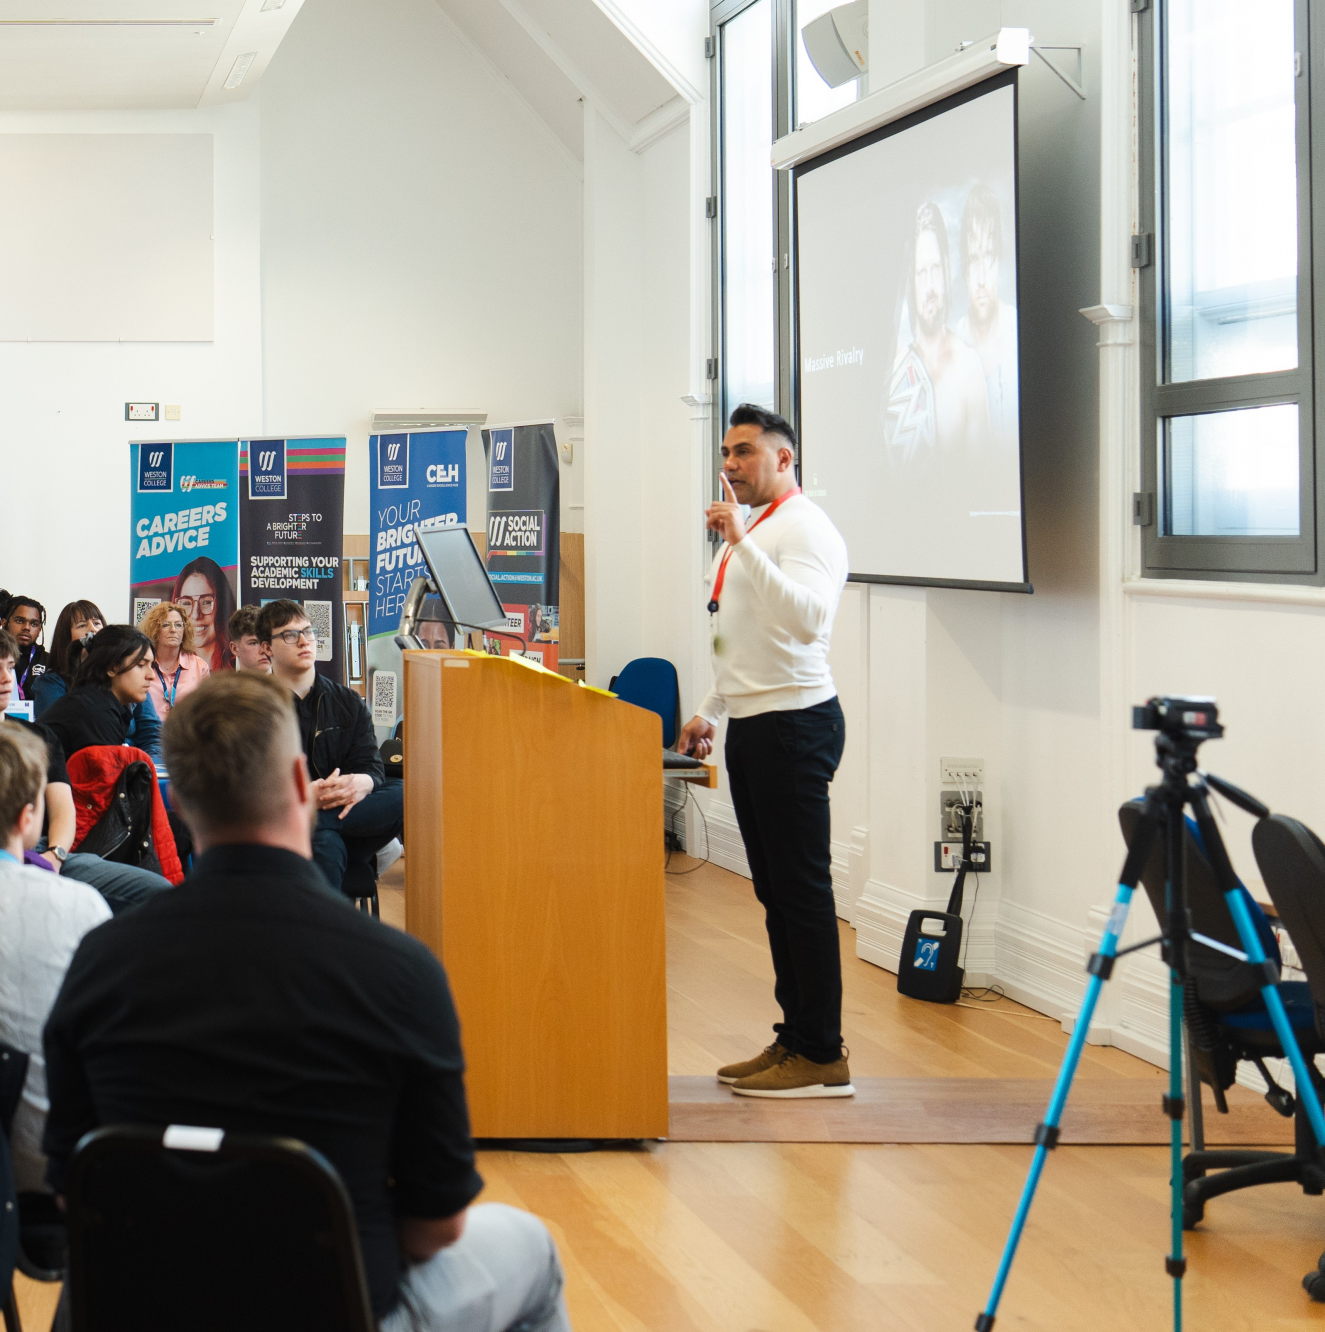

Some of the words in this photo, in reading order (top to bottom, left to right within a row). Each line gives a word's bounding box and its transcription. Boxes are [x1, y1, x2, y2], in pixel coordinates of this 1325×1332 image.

[804, 353, 835, 373] Massive
[836, 346, 864, 366] Rivalry
[383, 464, 403, 473] WESTON
[491, 465, 509, 474] WESTON
[255, 475, 282, 483] WESTON
[383, 474, 403, 482] COLLEGE
[492, 476, 509, 484] COLLEGE
[255, 484, 282, 493] COLLEGE
[288, 513, 311, 522] STEPS
[311, 513, 323, 522] TO
[378, 499, 421, 529] YOUR
[136, 502, 228, 538] CAREERS
[507, 515, 541, 531] SOCIAL
[266, 523, 272, 531] A
[272, 522, 307, 531] BRIGHTER
[274, 531, 303, 539] FUTURE
[503, 531, 538, 547] ACTION
[136, 526, 210, 559] ADVICE
[250, 556, 309, 567] SUPPORTING
[310, 556, 339, 568] YOUR
[250, 567, 299, 578] ACADEMIC
[300, 568, 335, 579] SKILLS
[250, 578, 320, 589] DEVELOPMENT
[375, 593, 407, 619] HER
